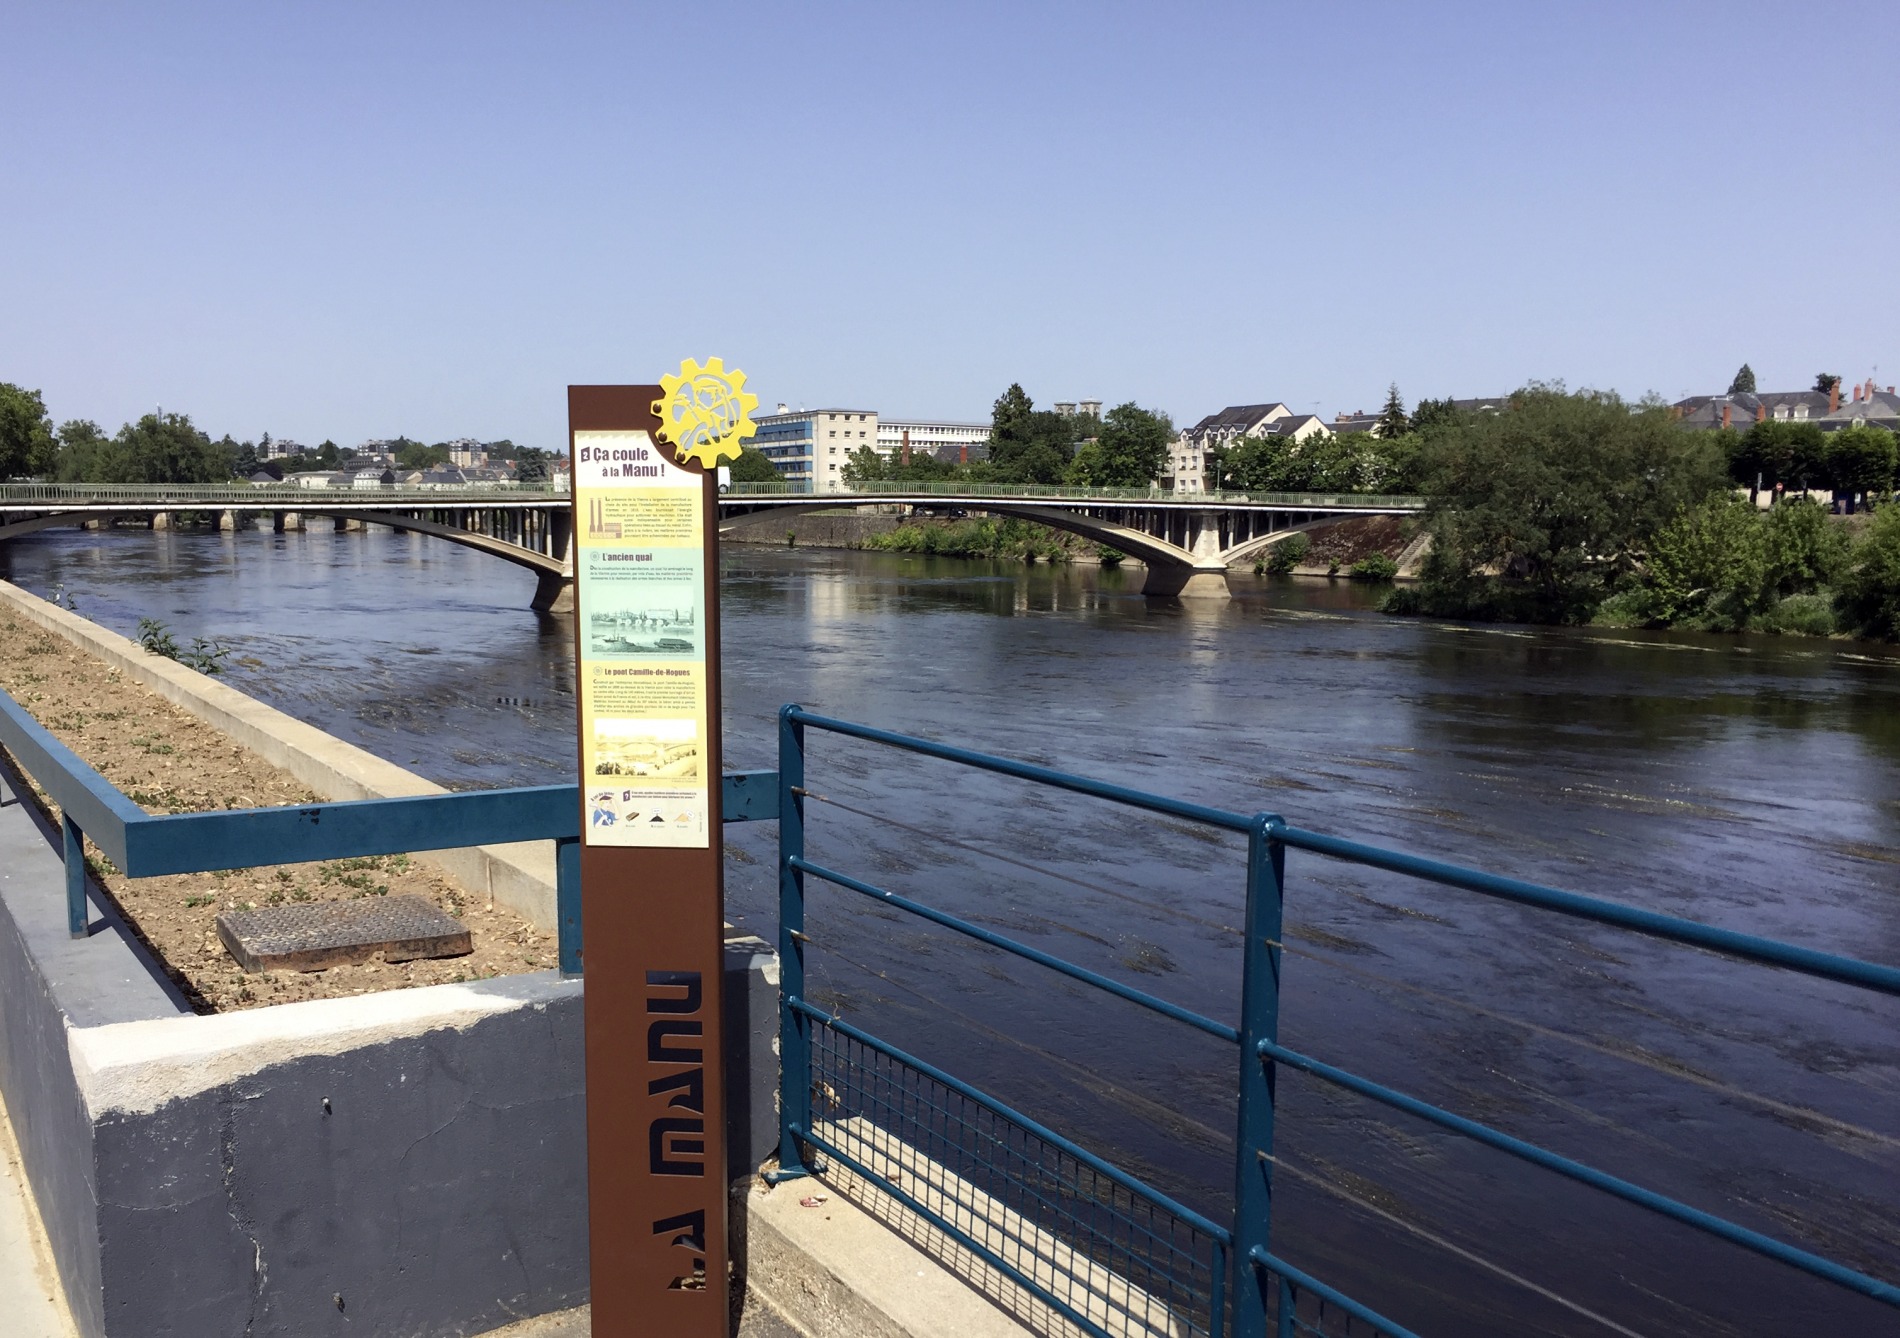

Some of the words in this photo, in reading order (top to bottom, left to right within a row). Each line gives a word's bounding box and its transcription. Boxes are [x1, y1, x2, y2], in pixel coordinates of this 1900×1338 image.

[582, 451, 589, 460] 2
[593, 447, 609, 464] Ça
[613, 447, 648, 461] coule
[602, 466, 608, 477] à
[610, 466, 620, 477] la
[622, 463, 658, 477] Manu
[602, 552, 634, 562] L'ancien
[635, 552, 653, 563] quai
[604, 668, 612, 676] Le
[613, 668, 628, 677] pont
[646, 970, 705, 1178] MANU
[653, 1208, 706, 1292] LA
